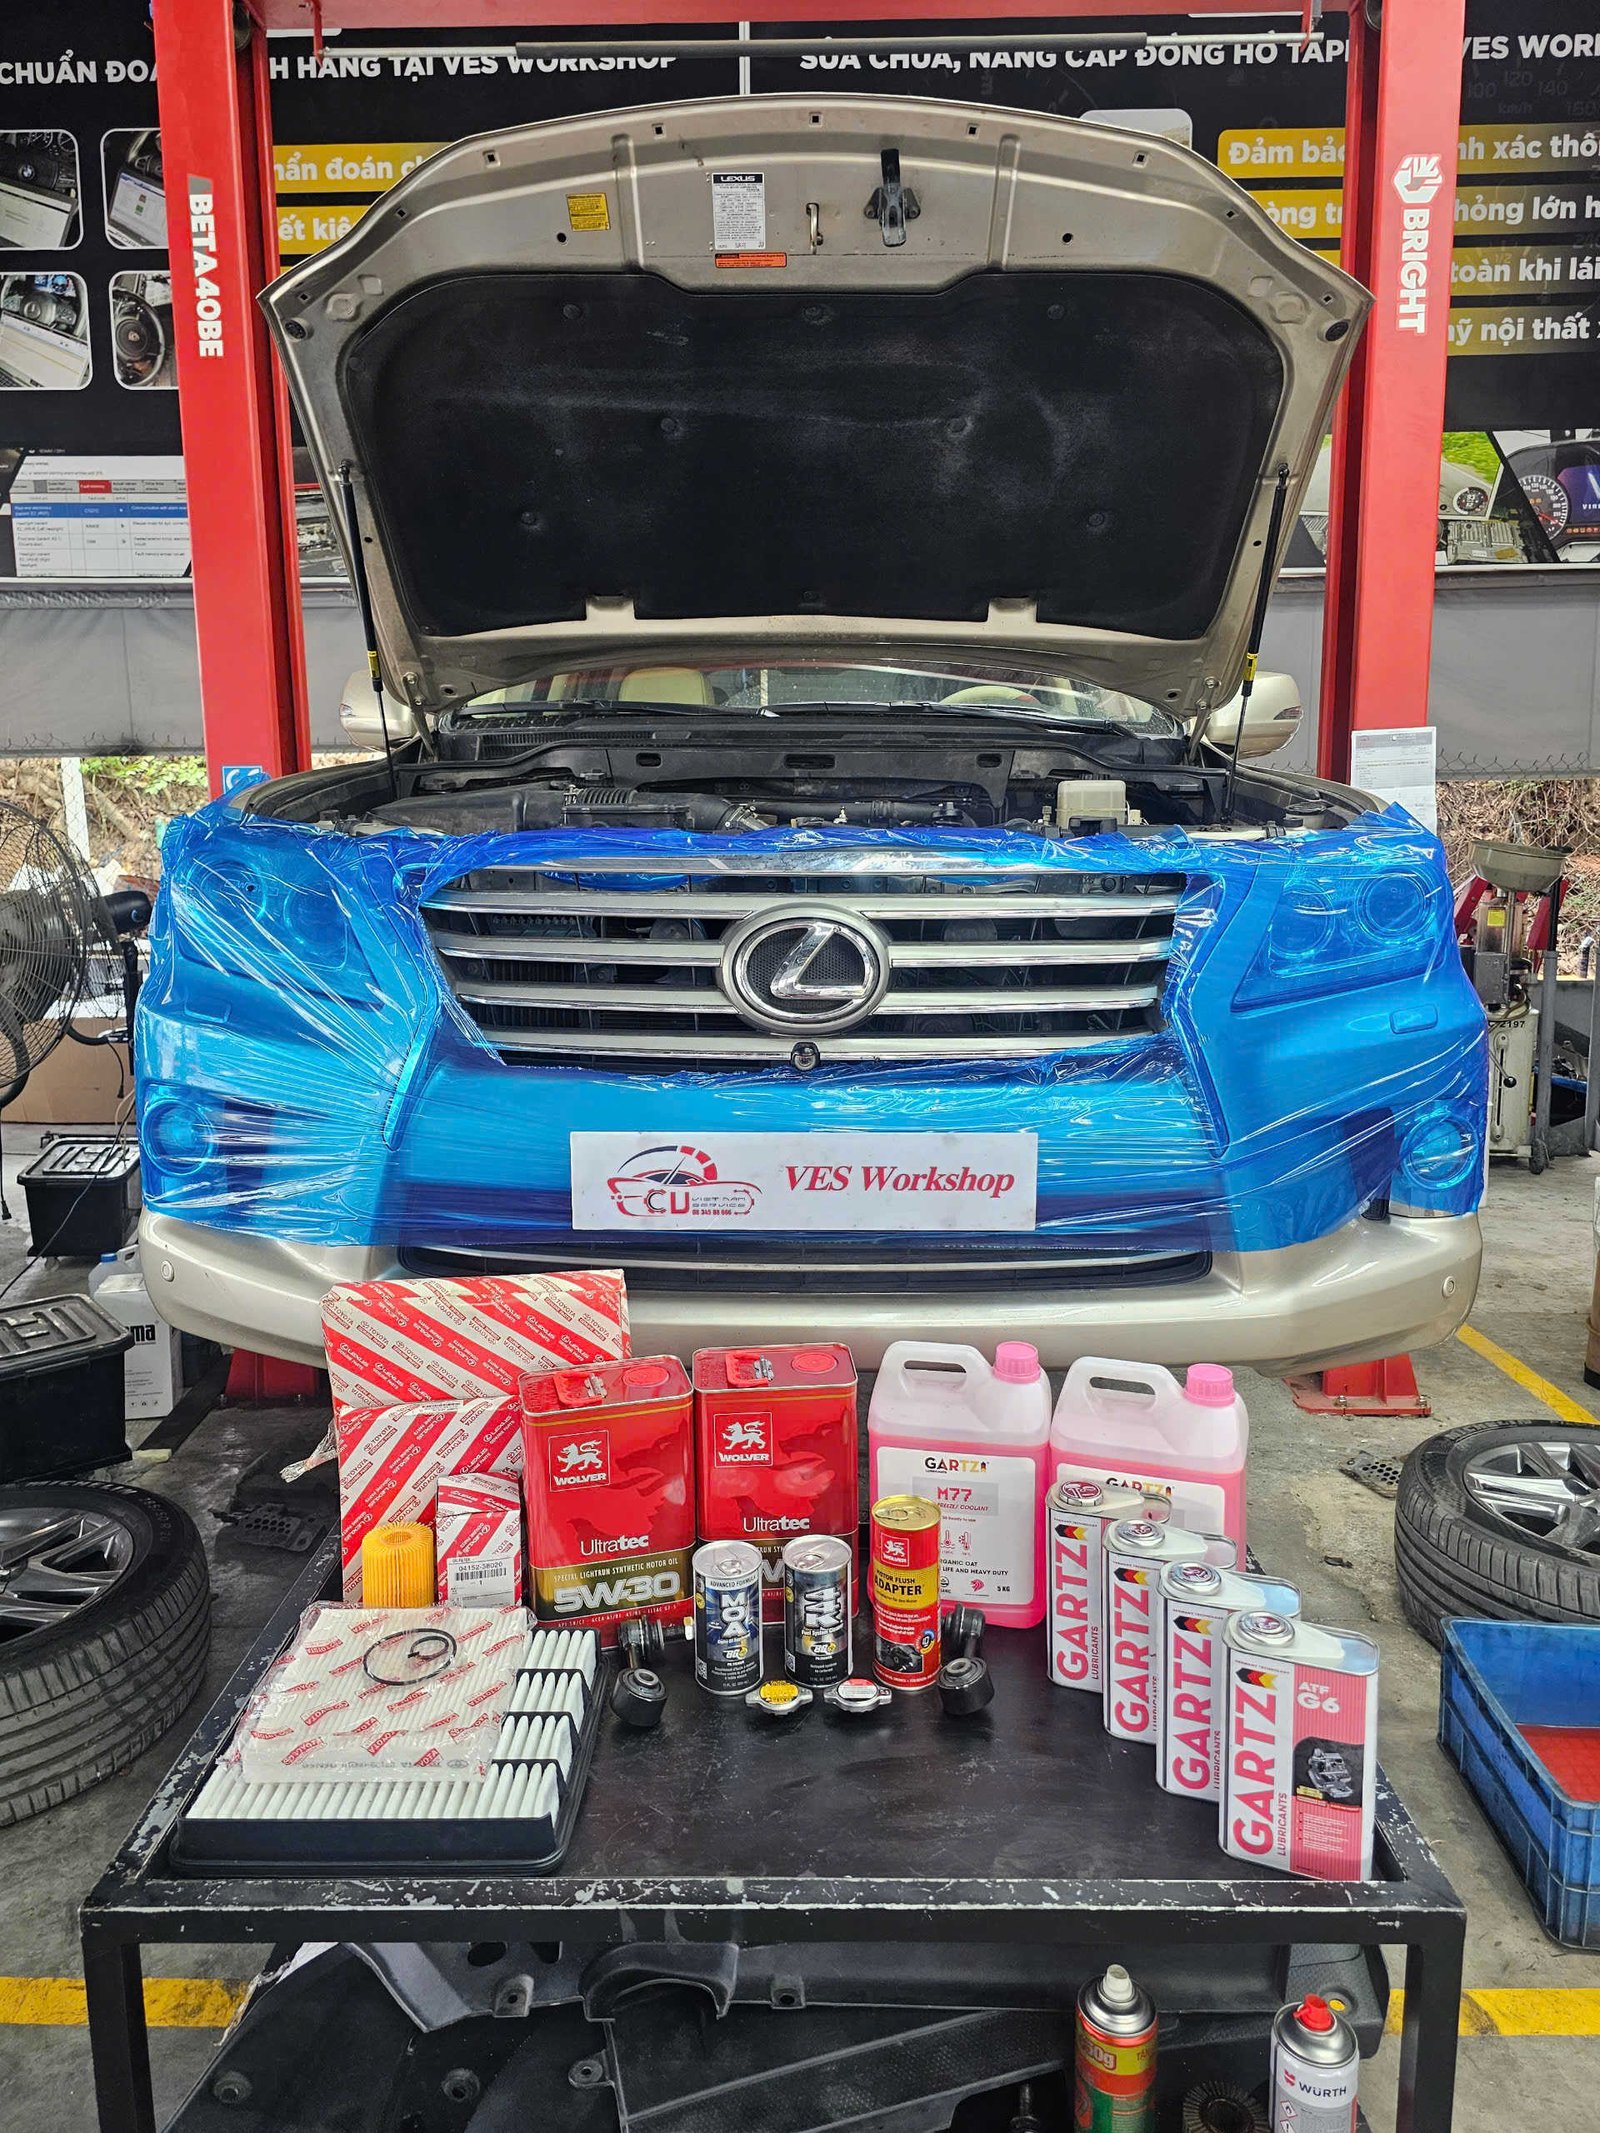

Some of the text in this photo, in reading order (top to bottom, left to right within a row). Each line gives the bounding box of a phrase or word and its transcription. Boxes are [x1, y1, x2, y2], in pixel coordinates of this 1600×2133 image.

[104, 59, 157, 83] ĐO
[445, 54, 499, 76] VES
[1228, 136, 1294, 165] Đảm
[1492, 134, 1543, 160] xác
[1532, 195, 1577, 221] lớn
[1398, 208, 1430, 334] BRIGHT
[1519, 257, 1561, 281] khi
[1480, 316, 1524, 347] nội
[1532, 311, 1591, 341] thất
[784, 1165, 1015, 1199] VES Workshop
[718, 1452, 770, 1463] WOLVER
[924, 1456, 980, 1472] GARTZ
[553, 1472, 607, 1486] WOLVER
[937, 1486, 973, 1502] M77
[743, 1515, 811, 1533] Ultratec
[580, 1534, 649, 1557] Ultratec
[612, 1562, 645, 1575] SYNTHETIC
[646, 1559, 667, 1570] MOTOR
[668, 1558, 679, 1566] OIL
[970, 1568, 992, 1576] HEAVY
[710, 1580, 736, 1588] ADVANCED
[874, 1575, 922, 1596] ADAPTER
[895, 1576, 916, 1584] FLUSH
[553, 1571, 681, 1614] 5W-30
[721, 1591, 748, 1640] MOA
[1055, 1540, 1089, 1681] GARTZ
[1091, 1626, 1099, 1680] LUBRICANTS
[1114, 1583, 1150, 1734] GARTZ
[1298, 1682, 1330, 1696] ATF
[1172, 1631, 1213, 1791] GARTZ
[1296, 1692, 1341, 1714] G6
[1232, 1686, 1277, 1856] GARTZ
[1277, 1792, 1288, 1856] LUBRICANTS
[1298, 2081, 1347, 2098] WÜRTH
